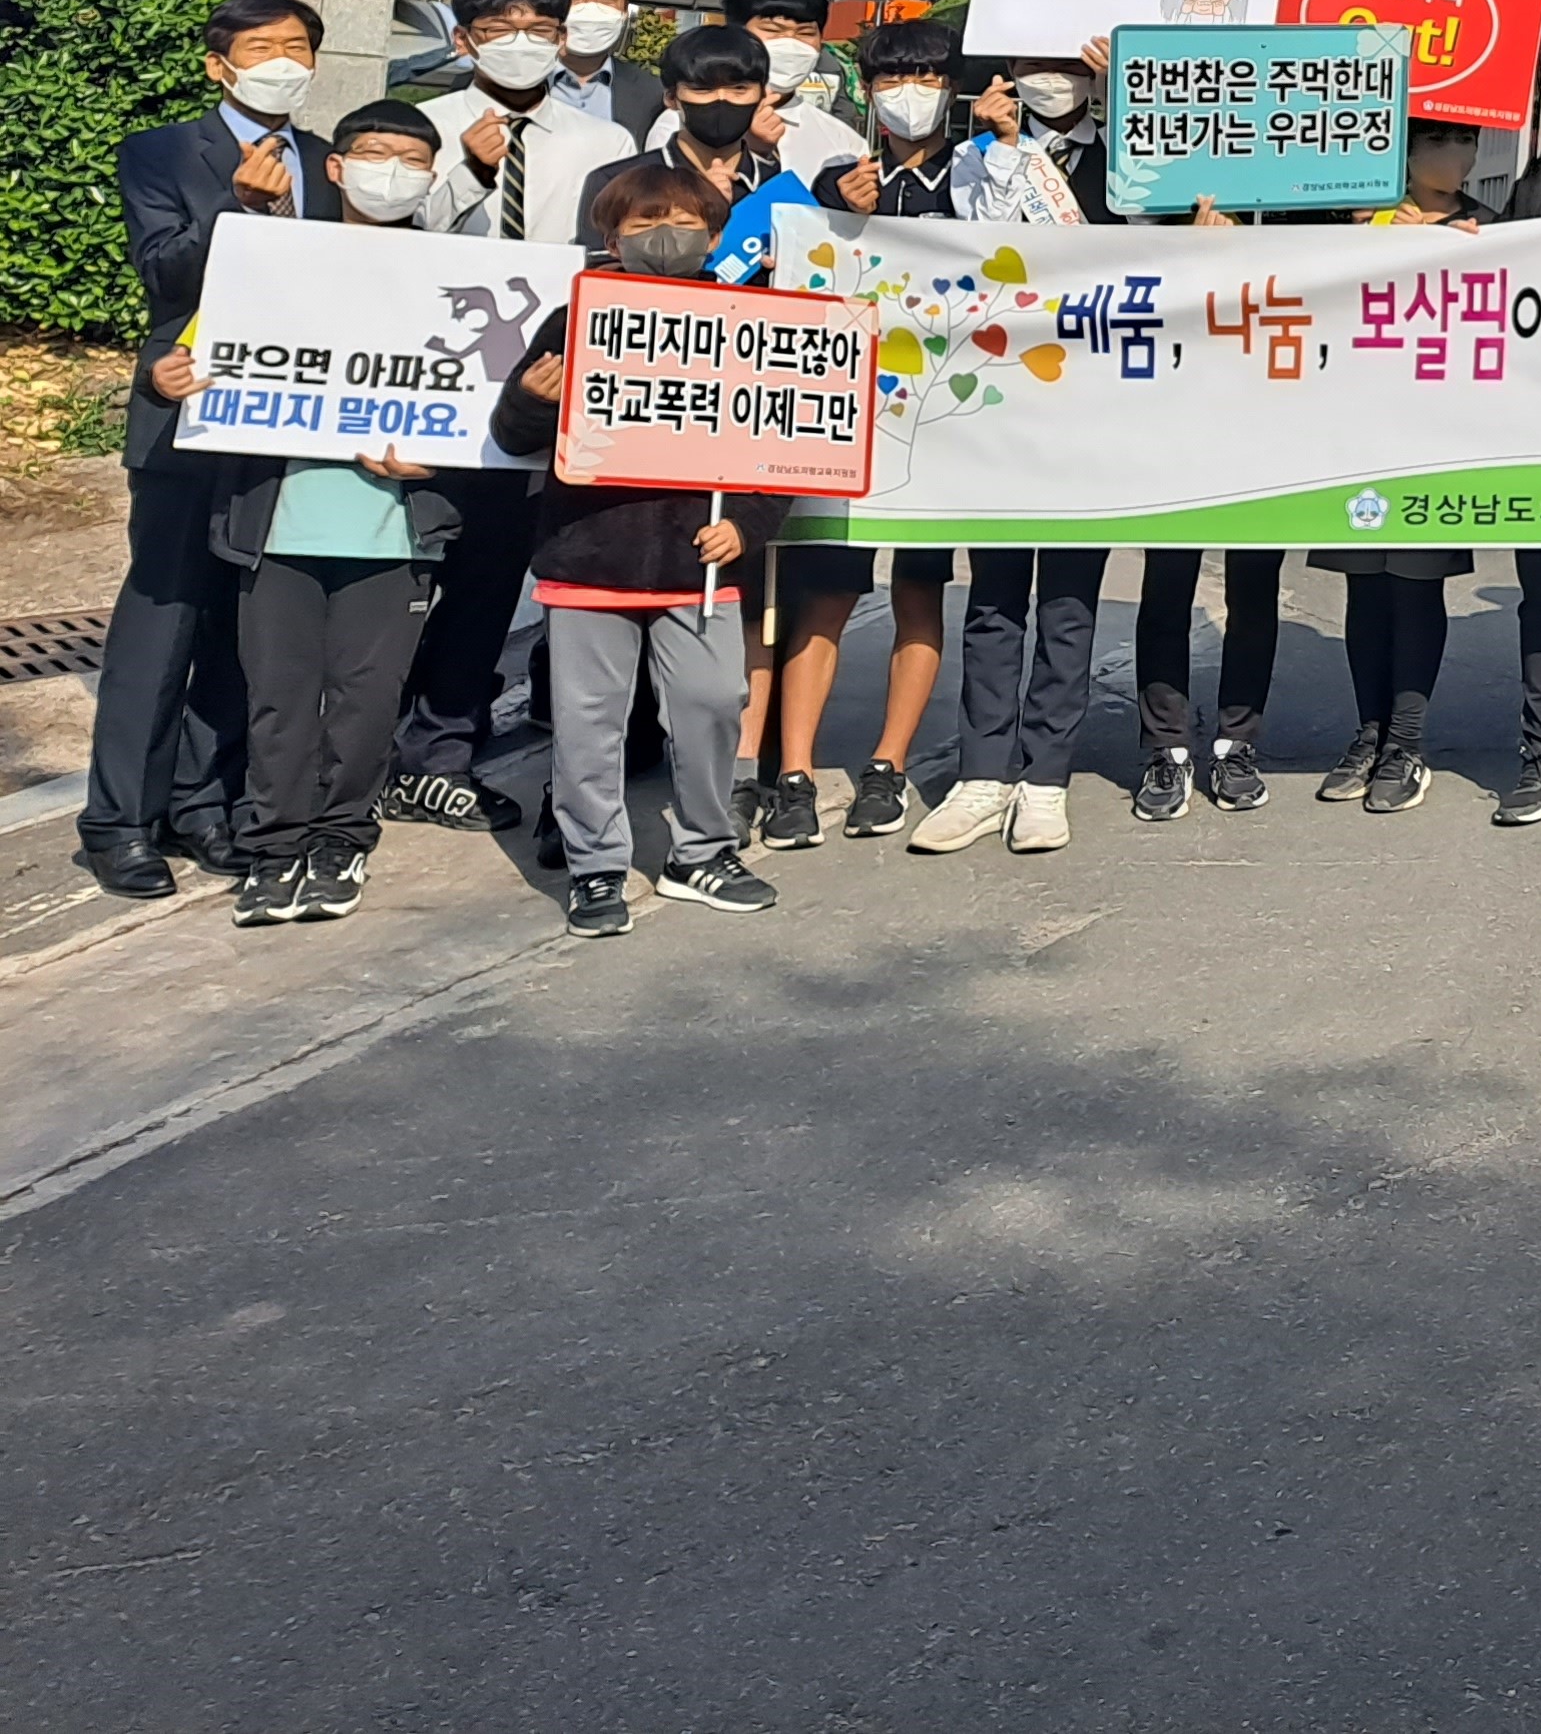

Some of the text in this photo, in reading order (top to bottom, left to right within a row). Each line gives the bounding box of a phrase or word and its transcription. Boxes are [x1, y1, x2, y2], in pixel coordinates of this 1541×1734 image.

[1124, 52, 1395, 104] 한번참은 주먹한대
[1123, 107, 1394, 158] 천년가는 우리우정
[588, 306, 862, 379] 때리지마 아프잖아
[1055, 275, 1184, 380] 베품,
[1205, 274, 1330, 380] 나눔,
[208, 340, 476, 393] 맞으면 아파요.
[200, 387, 470, 439] 때리지 말아요.
[584, 371, 858, 443] 학교폭력 이제그만
